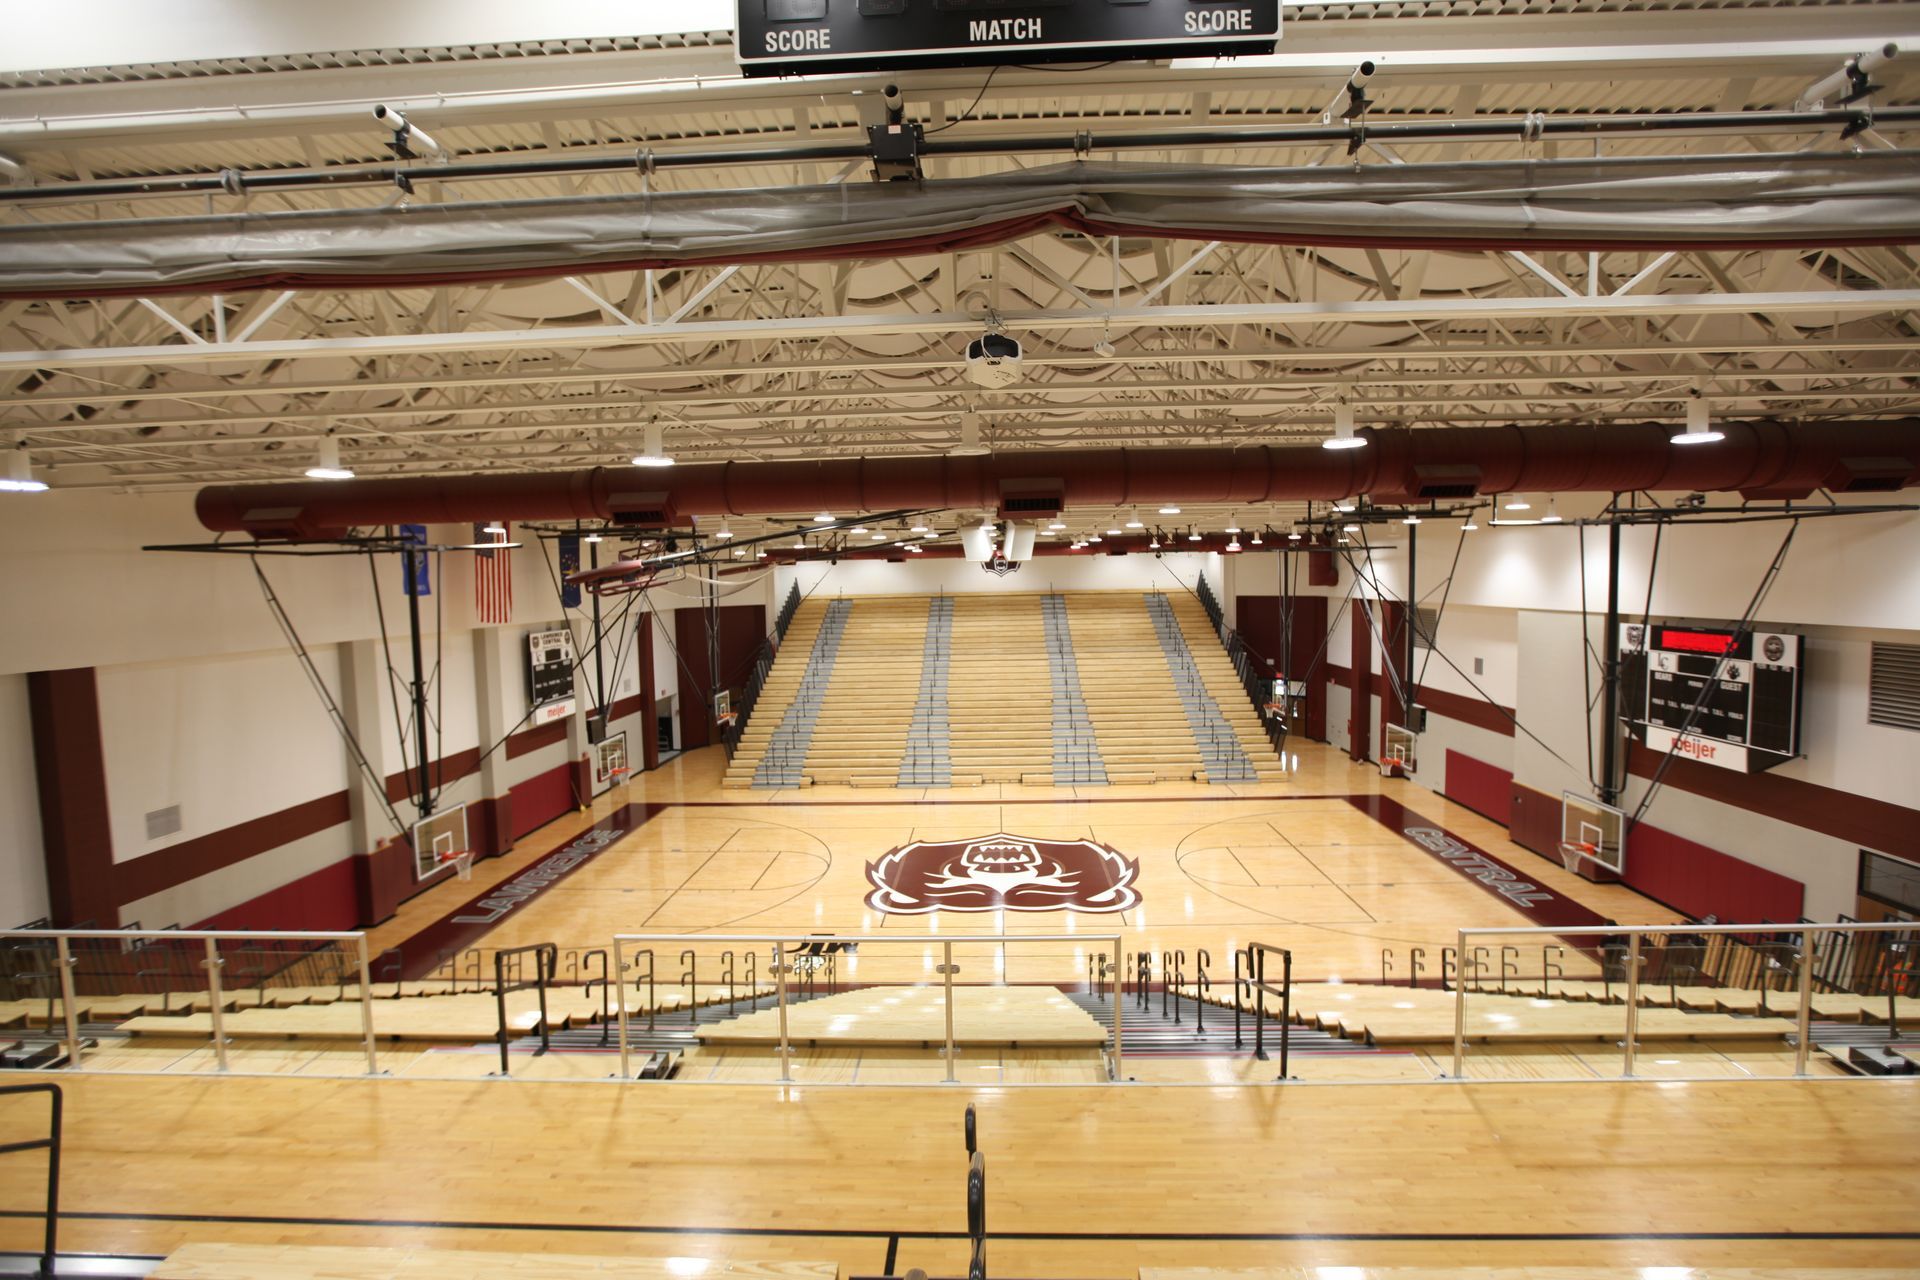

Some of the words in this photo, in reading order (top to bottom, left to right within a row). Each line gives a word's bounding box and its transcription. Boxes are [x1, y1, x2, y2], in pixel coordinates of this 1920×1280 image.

[969, 18, 1042, 41] MATCH
[1184, 9, 1252, 32] SCORE
[765, 29, 831, 52] SCORE
[450, 830, 624, 923] LAWRENCE
[1404, 827, 1554, 908] CENTRAL
